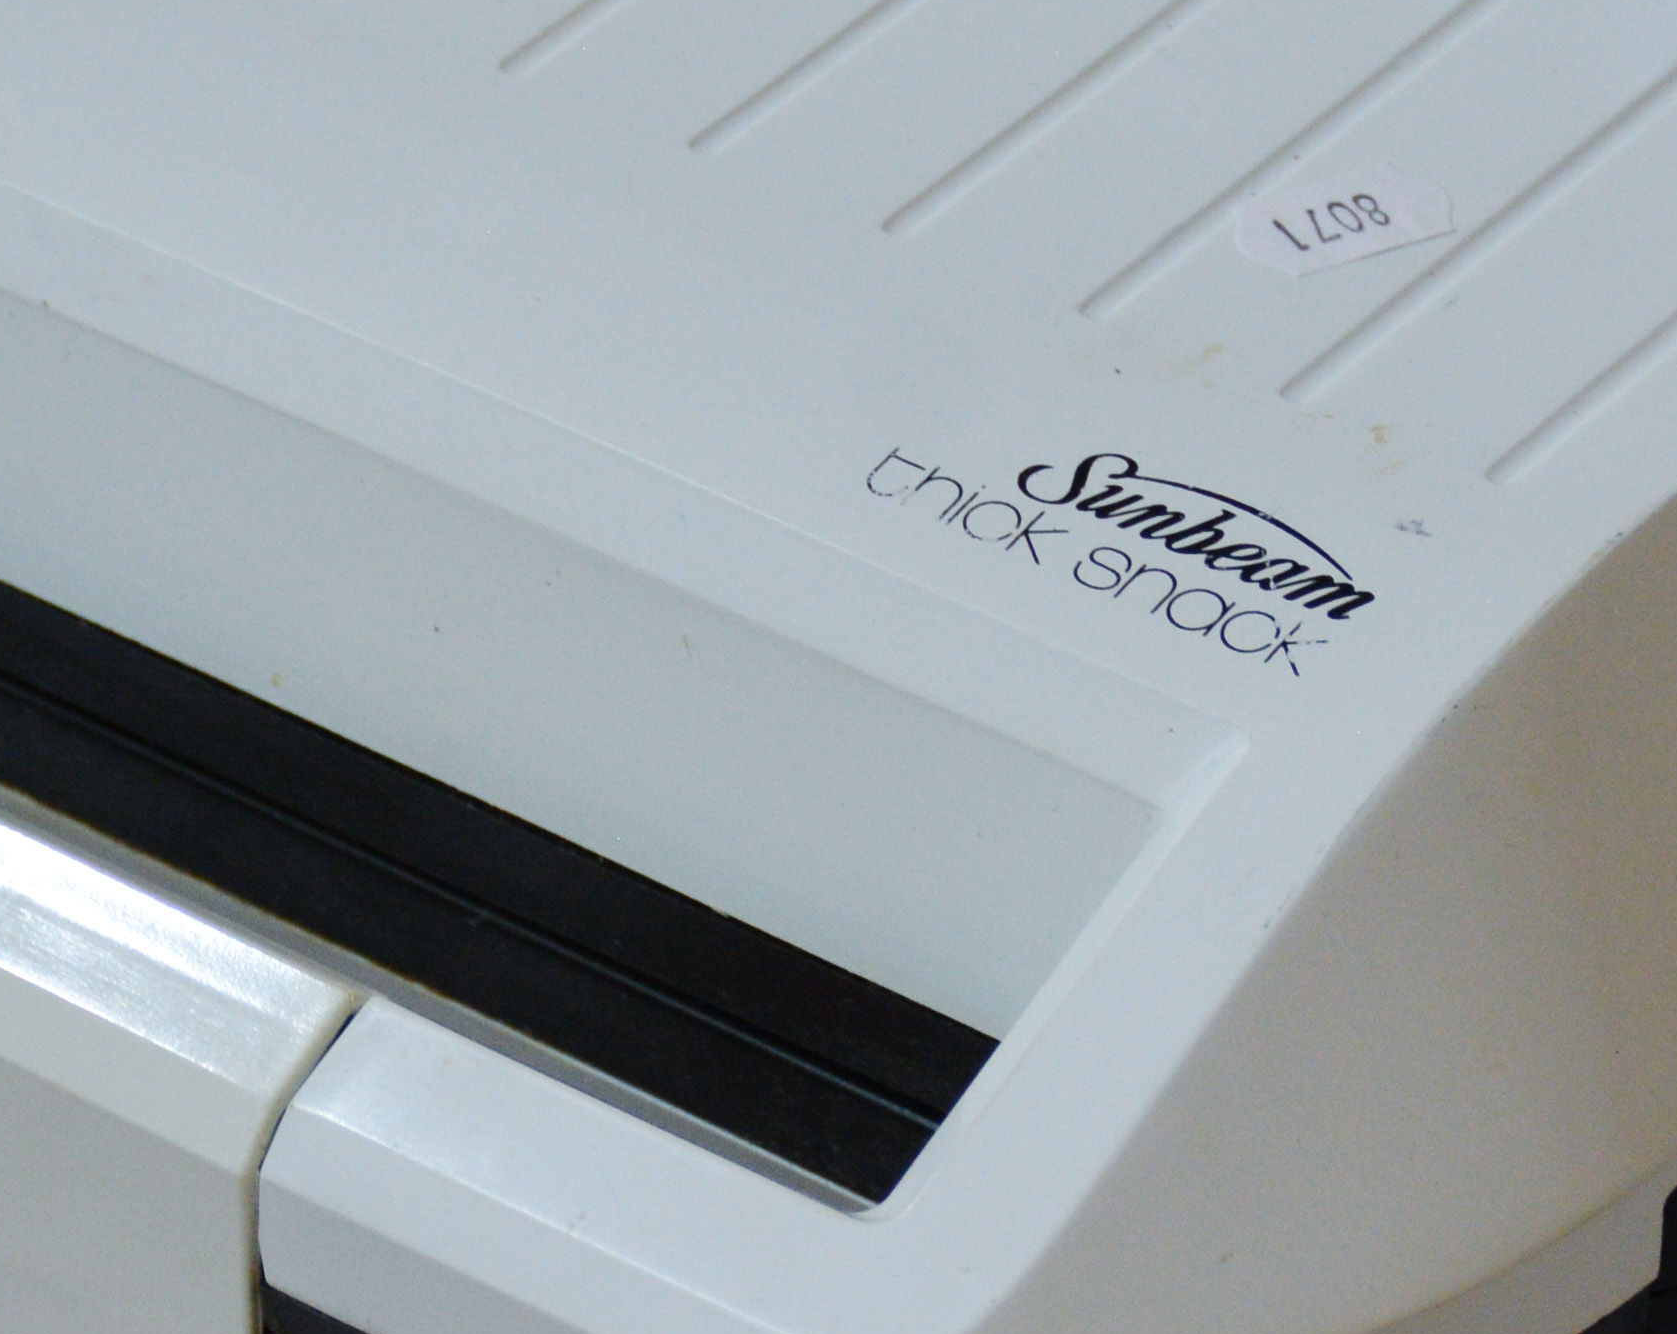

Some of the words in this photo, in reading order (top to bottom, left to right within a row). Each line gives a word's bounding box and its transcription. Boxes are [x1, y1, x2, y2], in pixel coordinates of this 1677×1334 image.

[865, 447, 1070, 565] thick
[1073, 546, 1328, 676] snack
[1016, 452, 1376, 621] Sunbeam
